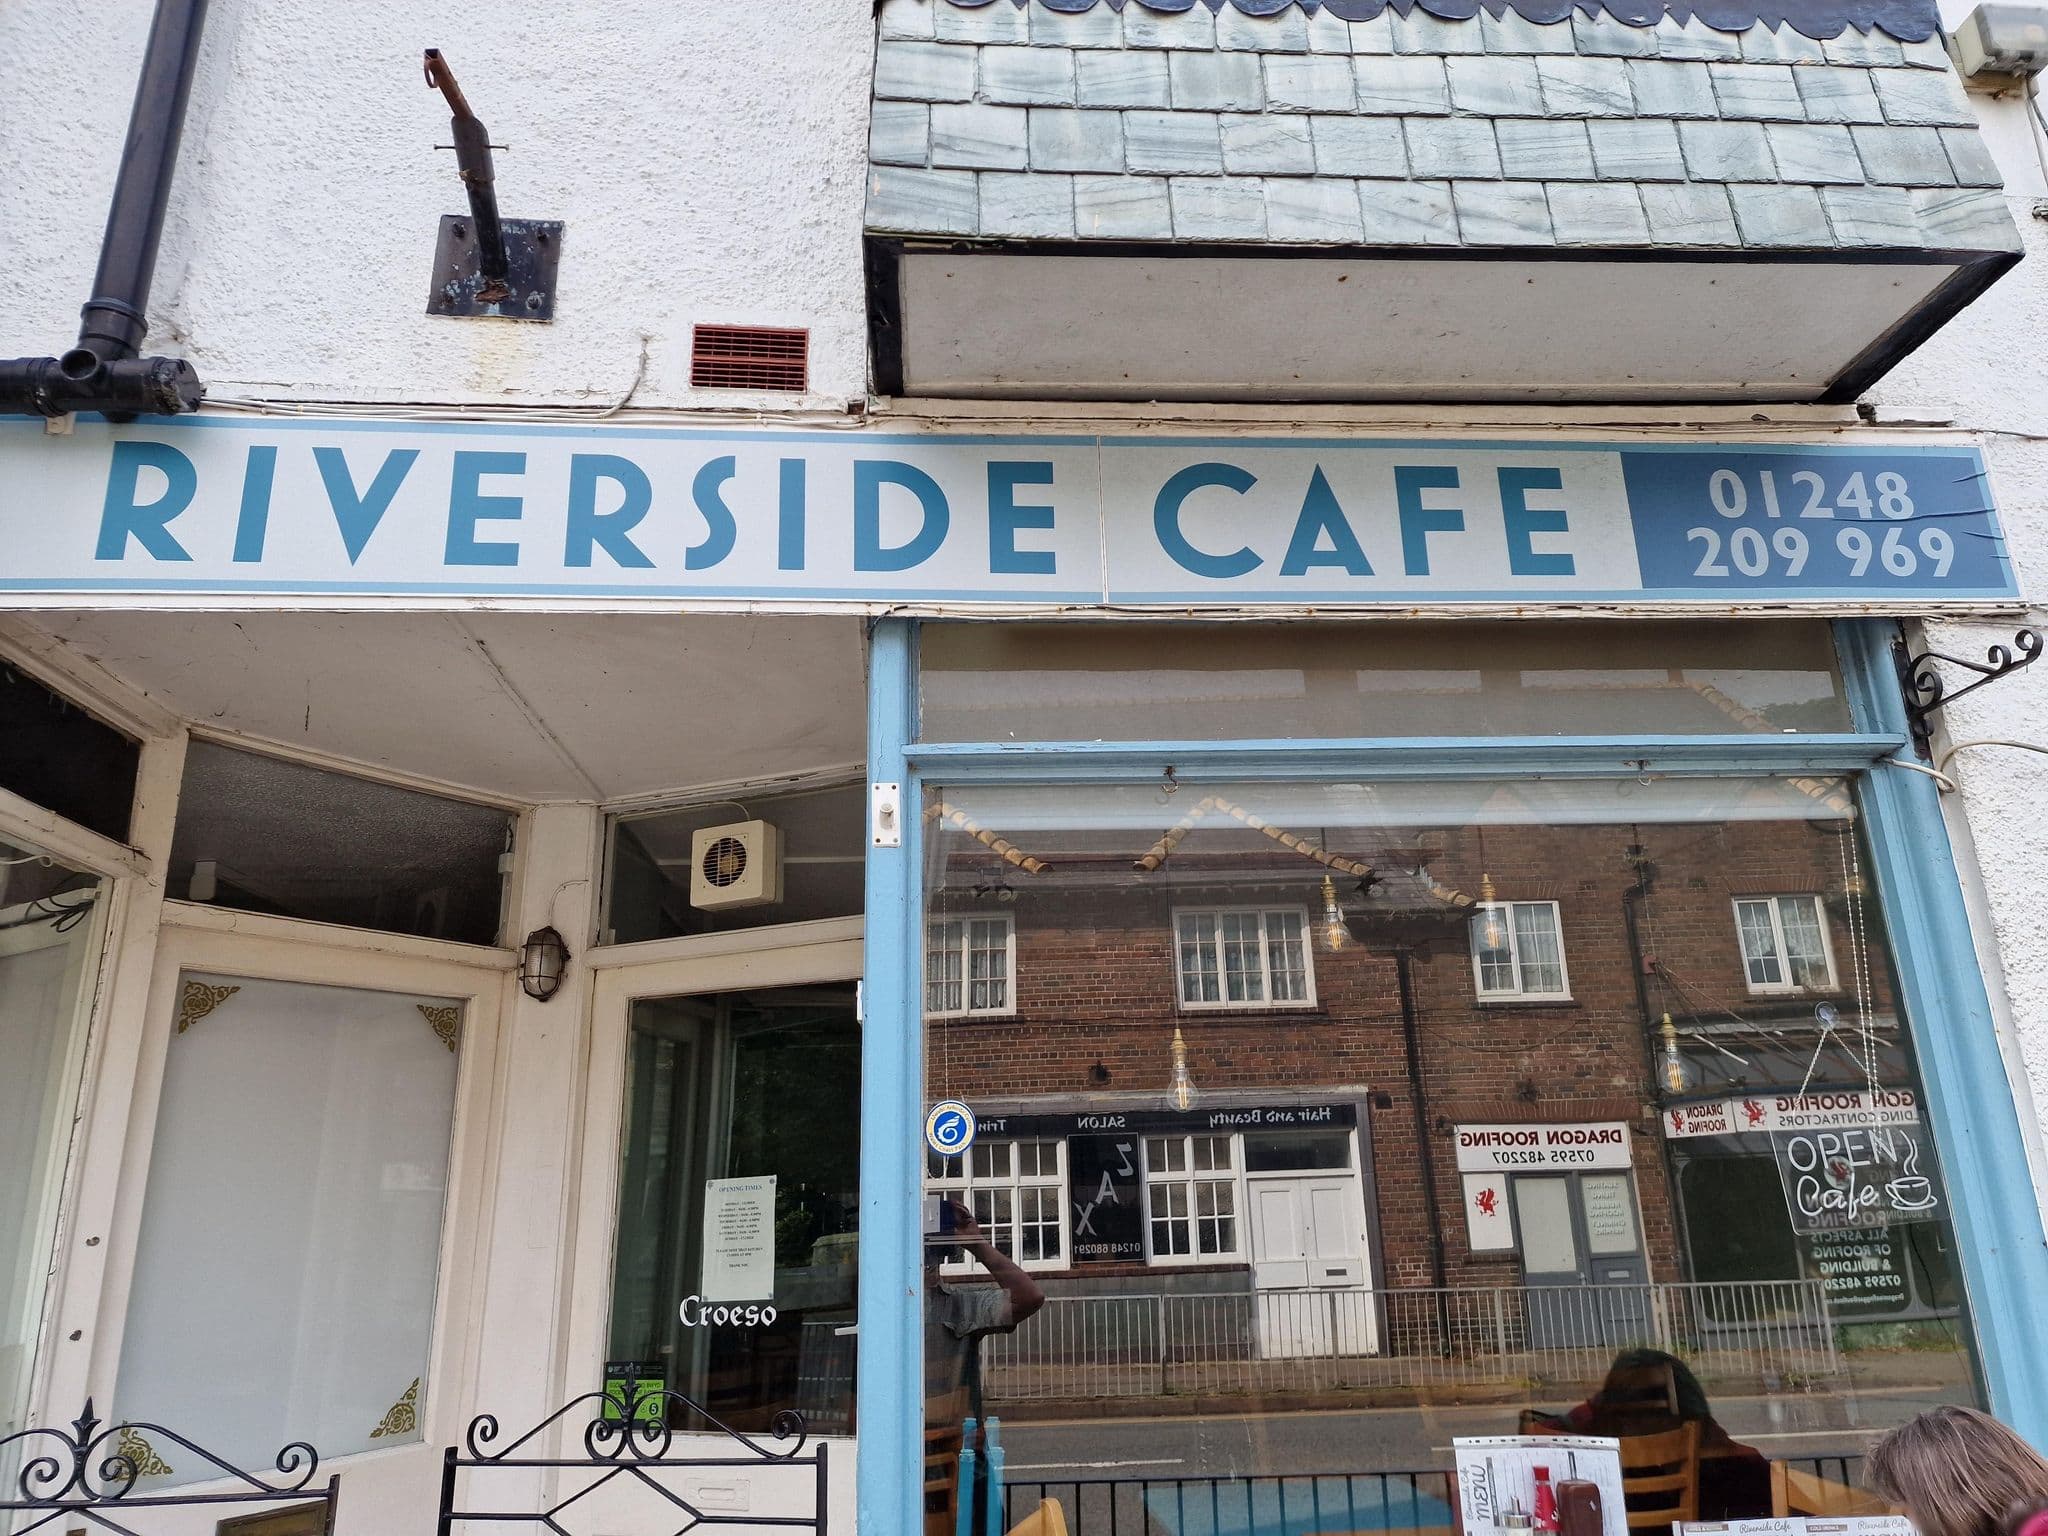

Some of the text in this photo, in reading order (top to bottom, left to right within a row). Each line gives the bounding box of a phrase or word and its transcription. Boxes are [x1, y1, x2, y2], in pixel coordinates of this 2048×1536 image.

[95, 440, 1576, 579] RIVERSIDE CAFE
[1709, 468, 1916, 521] 01248
[1686, 526, 1956, 578] 209 969
[1787, 1128, 1899, 1172] OPEN
[1796, 1175, 1880, 1220] Cafe
[679, 1294, 777, 1327] Croeso
[651, 1403, 657, 1414] 5
[1471, 1464, 1491, 1521] MENU
[1739, 1521, 1773, 1534] Riverside
[1774, 1519, 1792, 1533] Cafe
